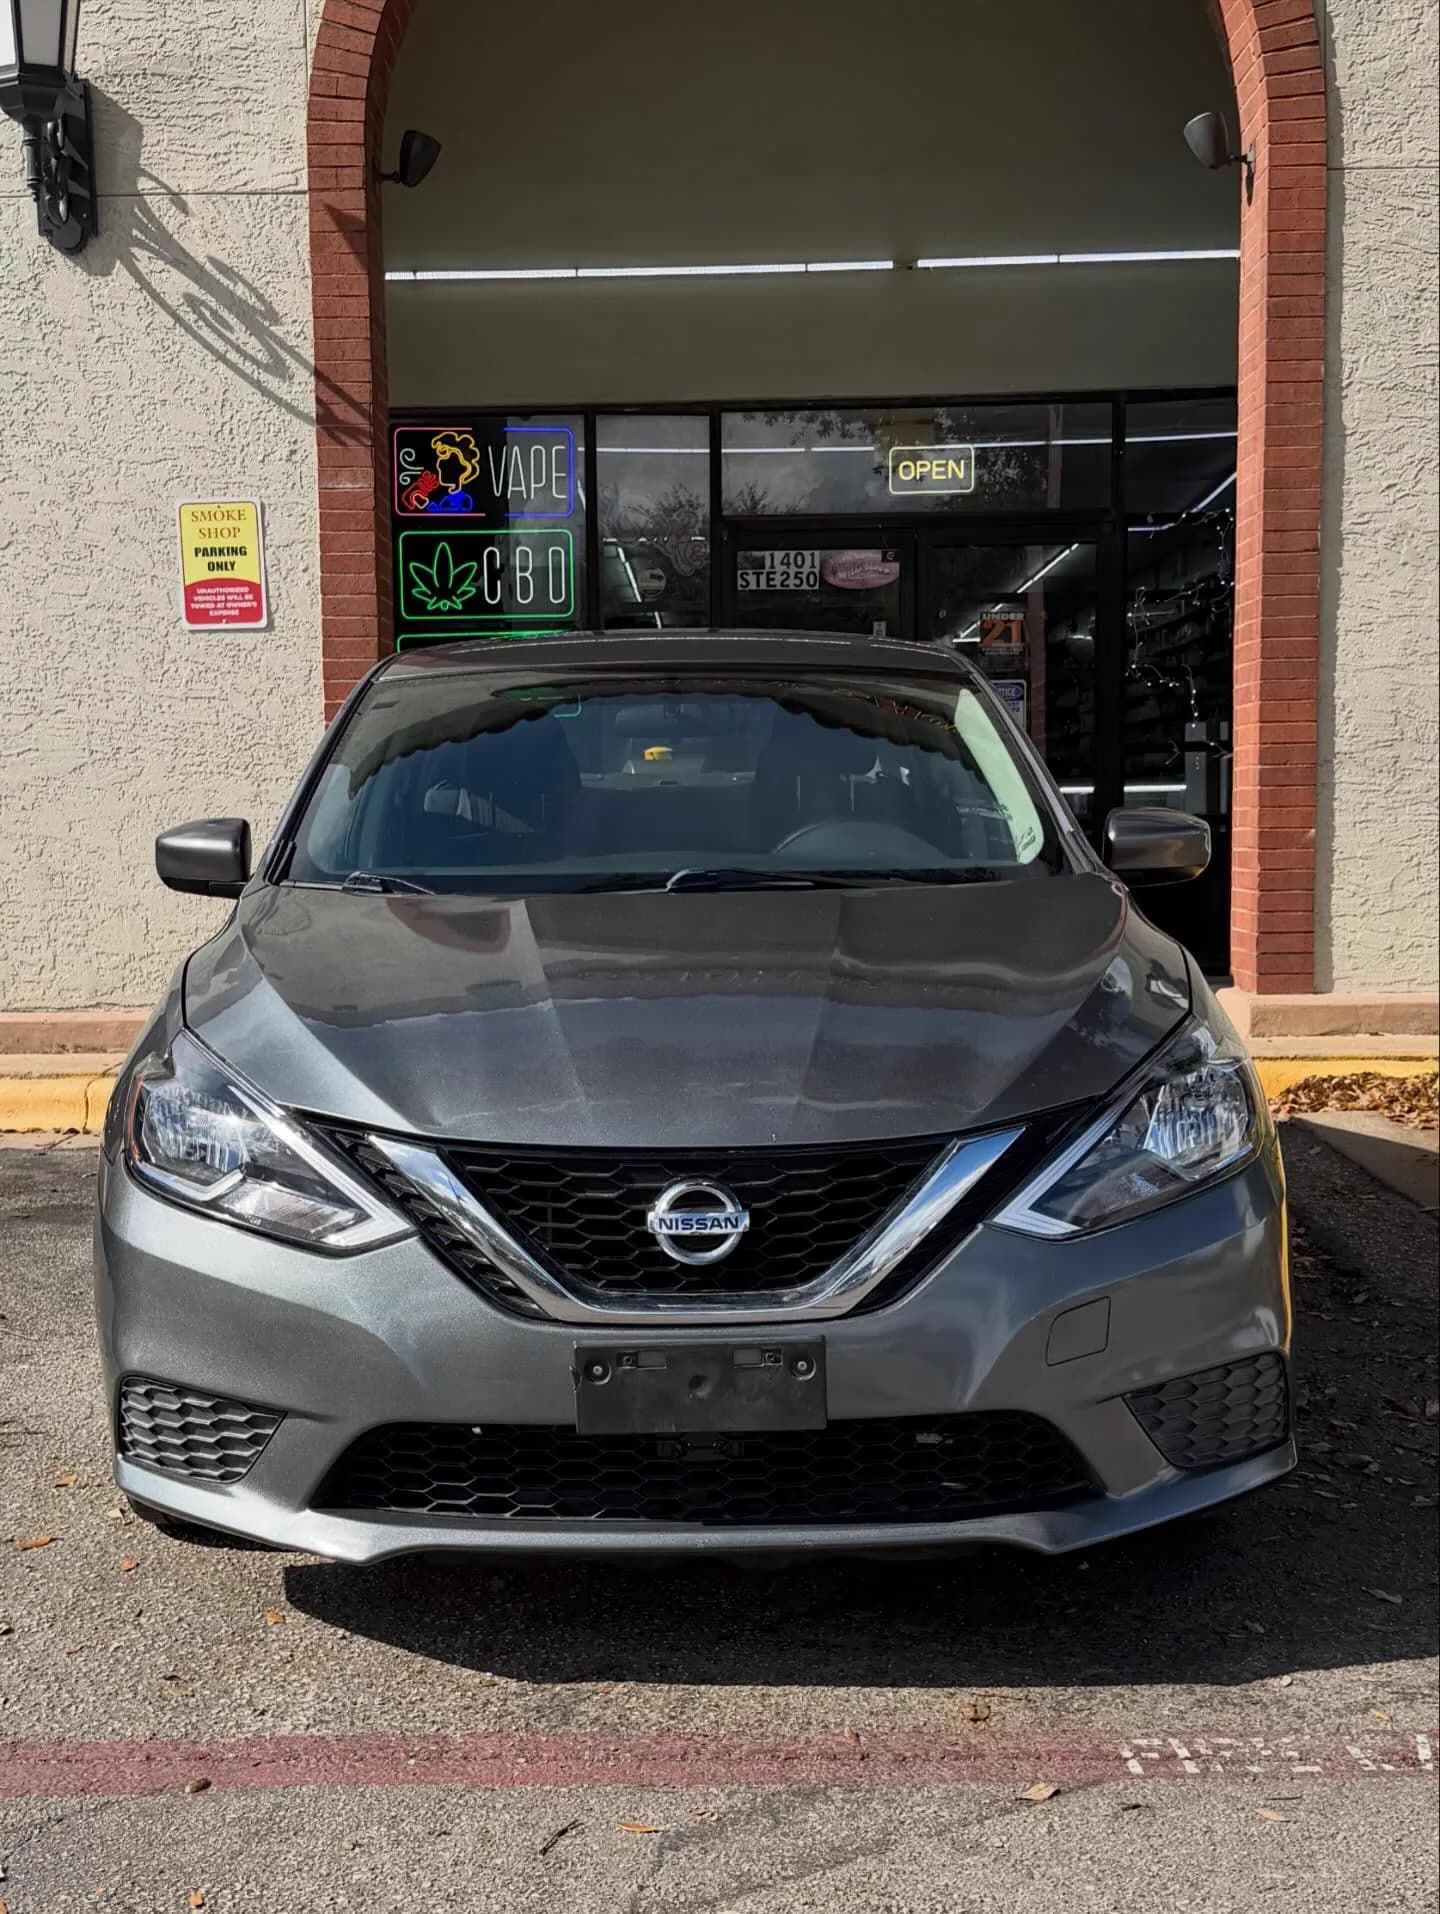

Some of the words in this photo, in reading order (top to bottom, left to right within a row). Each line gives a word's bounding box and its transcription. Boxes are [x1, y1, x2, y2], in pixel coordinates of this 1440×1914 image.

[488, 445, 568, 500] VAPE
[898, 459, 966, 481] OPEN
[191, 508, 247, 523] SMOKE
[199, 527, 241, 540] SHOP
[194, 546, 247, 558] PARKING
[766, 551, 817, 569] 1401
[207, 561, 236, 572] ONLY
[483, 546, 567, 604] CBD
[739, 570, 818, 588] STE250
[982, 612, 1024, 621] UNDER
[981, 621, 1023, 647] 21
[658, 1217, 739, 1231] NISSAN
